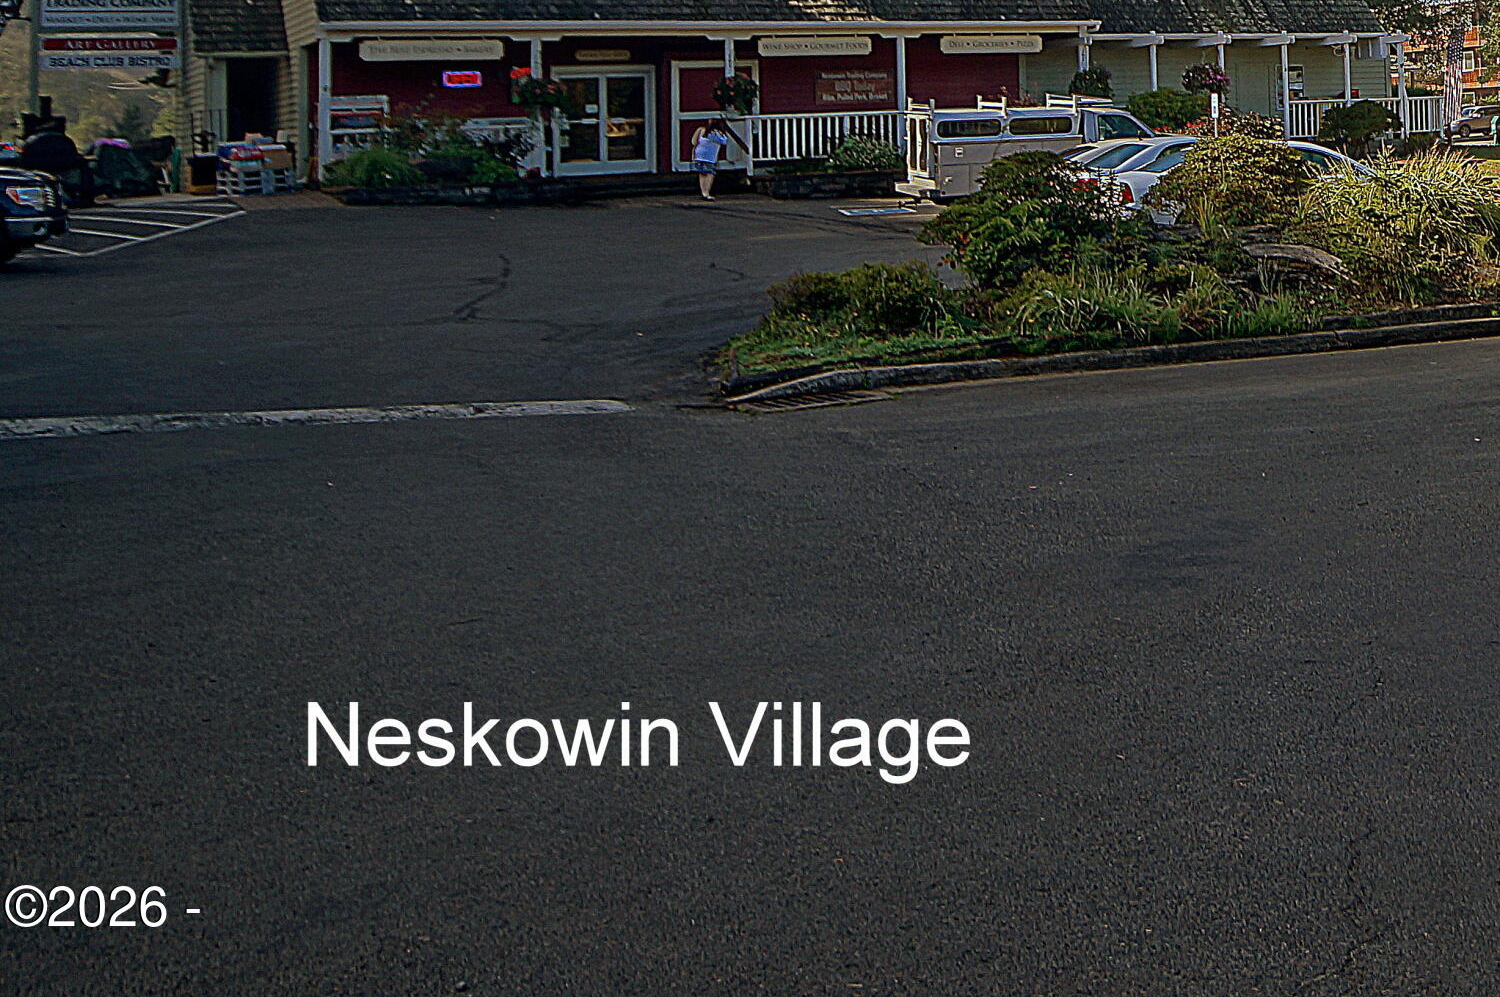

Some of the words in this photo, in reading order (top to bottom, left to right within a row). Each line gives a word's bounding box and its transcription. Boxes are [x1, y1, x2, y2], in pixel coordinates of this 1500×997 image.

[65, 40, 93, 50] ART
[96, 40, 157, 50] GALLERY
[48, 56, 90, 67] BEACH
[93, 56, 124, 67] CLUB
[128, 56, 170, 67] BISTRO
